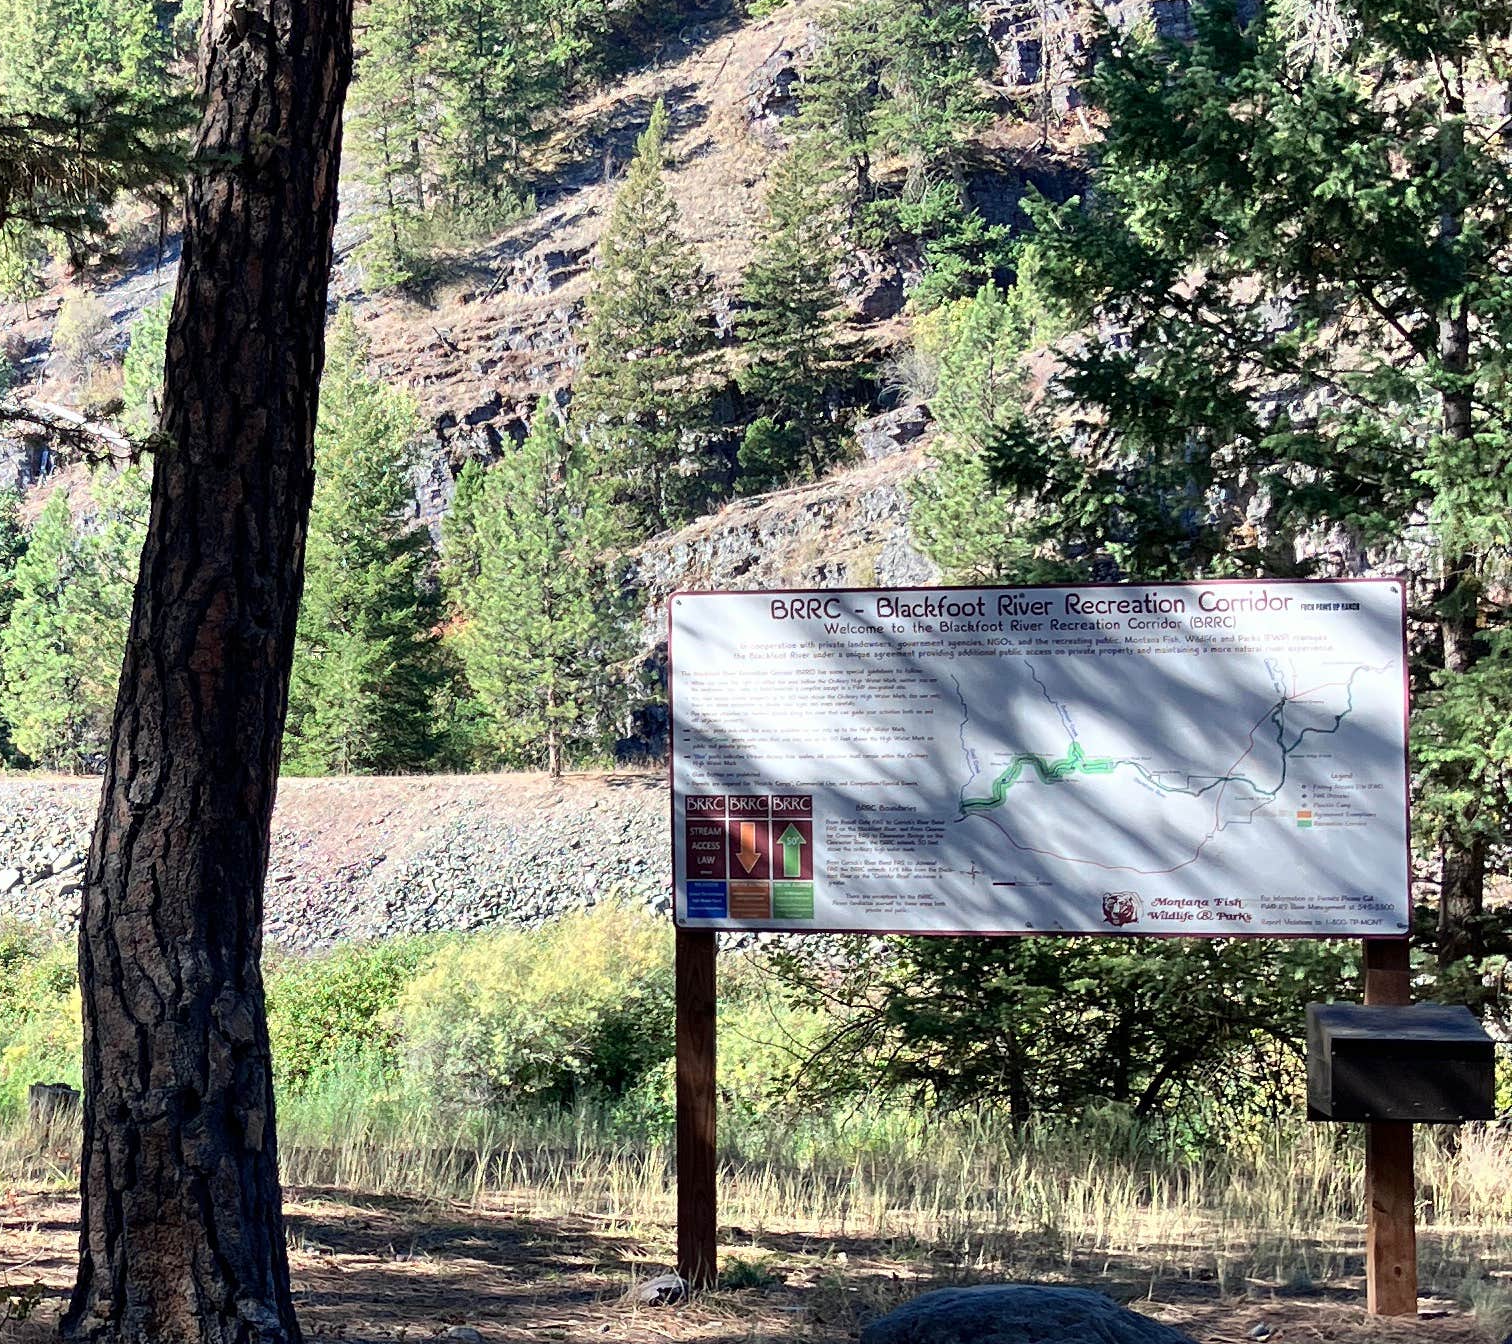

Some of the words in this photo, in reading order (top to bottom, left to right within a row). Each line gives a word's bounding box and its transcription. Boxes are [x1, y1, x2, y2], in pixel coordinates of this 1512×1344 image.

[770, 598, 841, 620] BRRC
[876, 596, 986, 618] Blackfoot
[997, 593, 1053, 616] River
[1065, 592, 1185, 616] Recreation
[1198, 589, 1293, 613] Corridor
[824, 623, 884, 635] Welcome
[892, 623, 904, 633] to
[913, 622, 933, 633] the
[940, 620, 1004, 633] Blackfoot
[1010, 619, 1043, 632] River
[1050, 618, 1120, 631] Recreation
[1128, 617, 1182, 630] Corridor
[1189, 616, 1237, 630] (BRRC)
[800, 640, 815, 649] with
[818, 640, 844, 651] private
[897, 639, 944, 651] government
[1018, 638, 1032, 646] and
[1036, 637, 1048, 646] the
[1052, 637, 1092, 647] recreating
[1124, 636, 1159, 644] Montana
[813, 649, 834, 658] under
[846, 650, 870, 659] unique
[874, 648, 915, 659] agreement
[918, 647, 954, 659] providing
[958, 647, 995, 656] additional
[999, 647, 1021, 657] public
[1026, 648, 1051, 656] access
[1068, 646, 1095, 657] private
[1099, 645, 1133, 656] property
[1137, 644, 1150, 654] and
[687, 797, 725, 811] BRRC
[730, 797, 769, 811] BRRC
[773, 797, 811, 811] BRRC
[690, 826, 721, 836] STREAM
[692, 841, 720, 850] ACCESS
[697, 856, 716, 864] LAW
[1151, 897, 1210, 909] Montana
[1213, 897, 1244, 909] Fish
[1147, 909, 1195, 922] Wildlife
[1196, 909, 1214, 921] &
[1216, 911, 1253, 924] Parks
